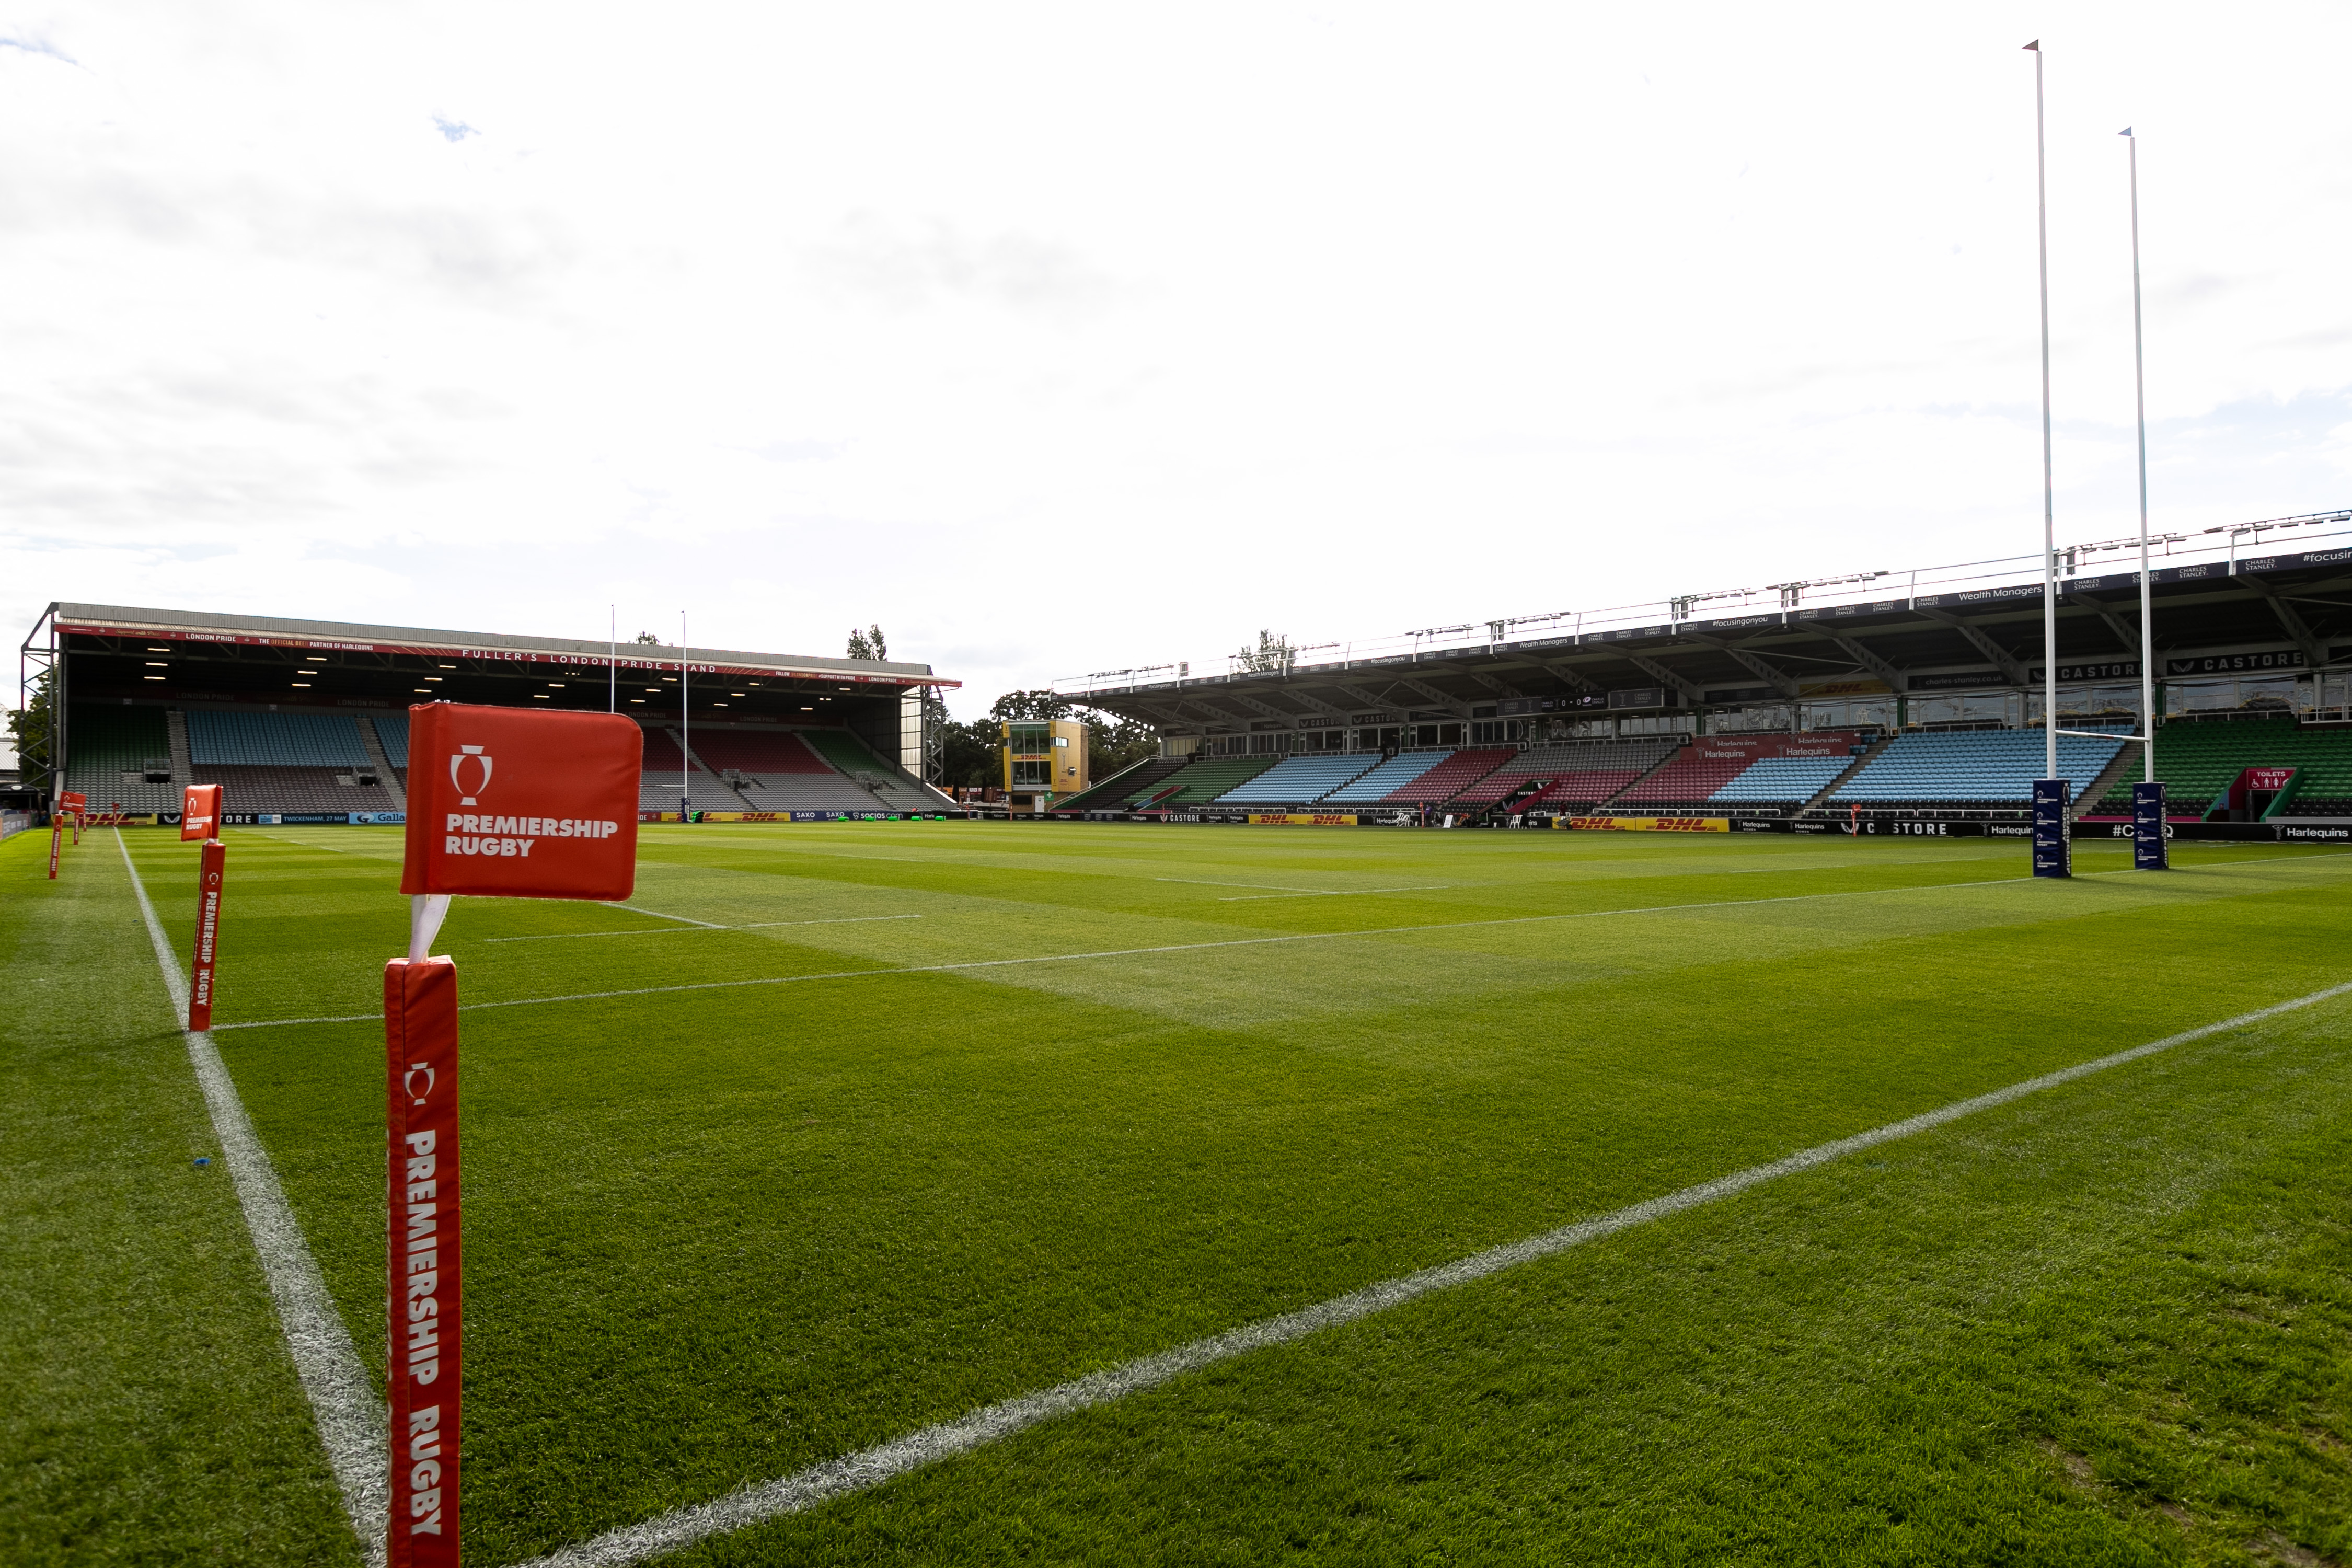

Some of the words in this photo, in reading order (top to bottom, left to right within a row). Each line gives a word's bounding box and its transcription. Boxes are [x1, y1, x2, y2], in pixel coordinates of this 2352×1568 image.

[1959, 590, 1991, 601] Wealth
[1993, 585, 2042, 597] Managers
[1712, 617, 1768, 627] #focusingonyou
[1539, 638, 1568, 646] Managers
[463, 650, 537, 662] FULLER'S
[550, 655, 609, 666] LONDON
[621, 660, 663, 670] PRIDE
[2204, 652, 2302, 671] CASTORE
[1926, 675, 2003, 685] charles-stanley.co.uk
[1824, 684, 1864, 693] DHL
[1705, 750, 1745, 759] Harlequins
[1786, 746, 1830, 757] Harlequins
[377, 813, 406, 822] Galla
[1260, 814, 1290, 824] DHL
[1313, 815, 1345, 825] DHL
[447, 813, 618, 838] PREMIERSHIP
[1570, 818, 1616, 830] DHL
[1655, 818, 1708, 831] DHL
[1867, 823, 1946, 835] CSTORE
[1991, 826, 2033, 835] Harlequin
[2287, 828, 2348, 838] Harlequins
[445, 836, 534, 857] RUGBY
[201, 891, 217, 963] PREMIERSHIP
[197, 969, 210, 1006] RUGBY
[405, 1129, 439, 1386] PREMIERSHIP
[410, 1404, 442, 1537] RUGBY
